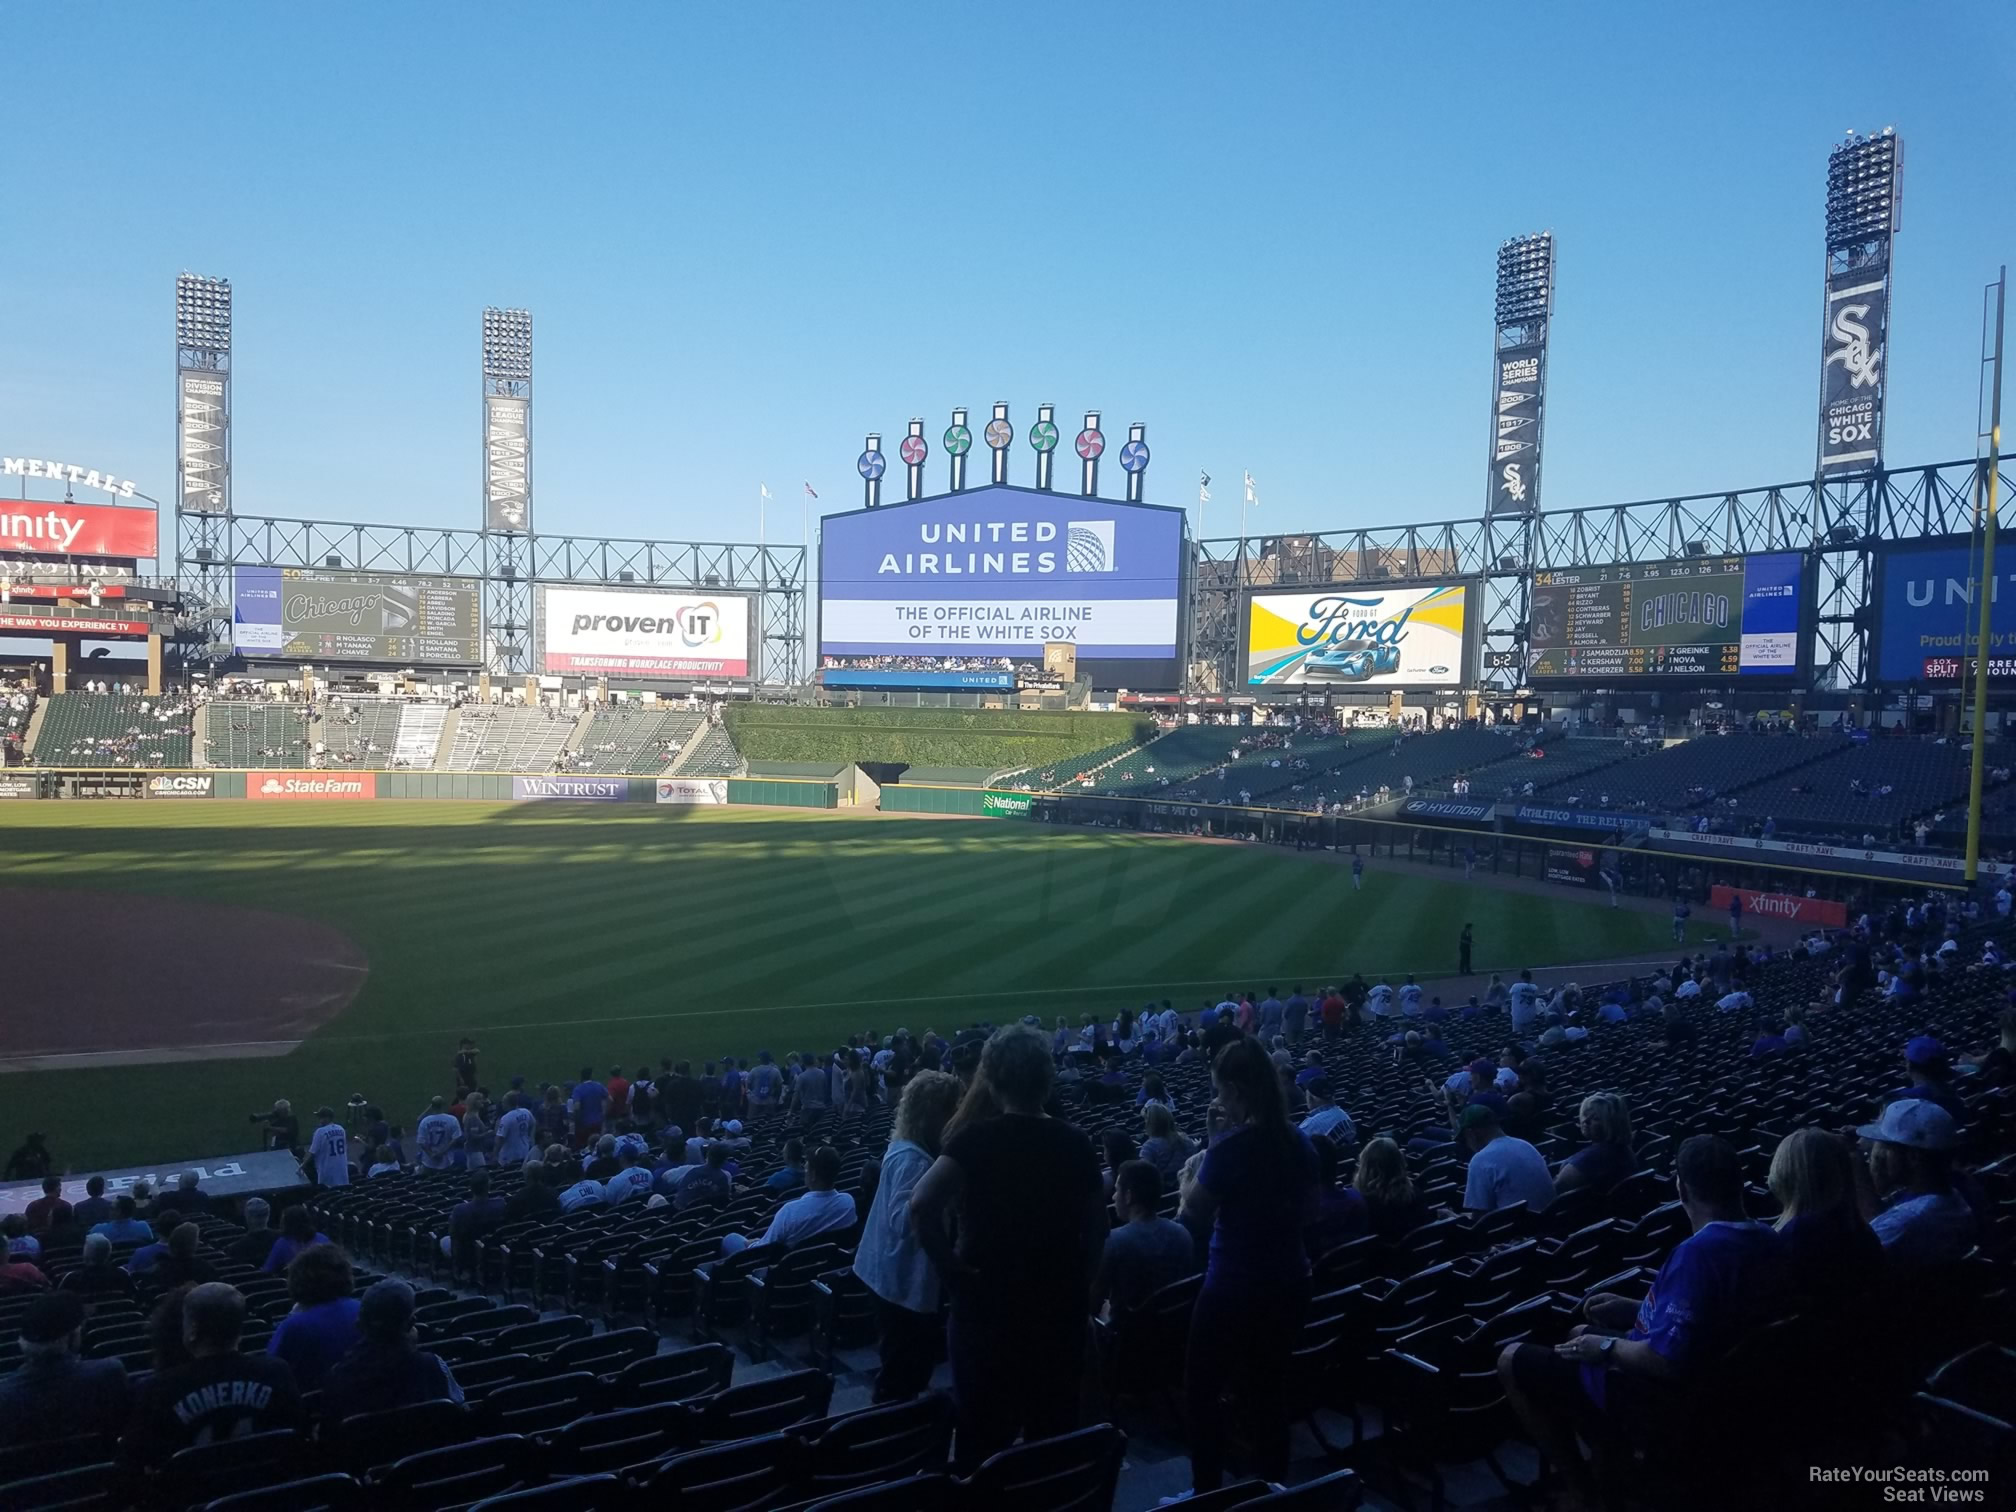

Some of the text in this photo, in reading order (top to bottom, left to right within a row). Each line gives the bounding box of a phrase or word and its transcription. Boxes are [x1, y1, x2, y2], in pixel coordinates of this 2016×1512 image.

[1502, 358, 1538, 371] WORLD
[1502, 366, 1538, 380] SERIES
[185, 382, 222, 391] DIVISION
[1502, 376, 1537, 386] CHAMPIONS
[1501, 394, 1524, 404] 2005
[1830, 398, 1849, 407] HOME
[1850, 396, 1859, 405] OF
[491, 406, 524, 414] AMERICAN
[1829, 402, 1873, 416] CHICAGO
[491, 412, 524, 420] LEAGUE
[1829, 411, 1873, 427] WHITE
[1501, 419, 1523, 428] 1917
[1829, 423, 1872, 445] SOX
[3, 457, 137, 498] MENTALS
[921, 522, 1057, 544] UNITED
[877, 552, 1058, 574] AIRLINES
[283, 568, 301, 580] 50
[1535, 573, 1552, 586] 34
[1552, 576, 1580, 585] LESTER
[1644, 570, 1659, 578] 3.95
[1670, 568, 1690, 576] 123.0
[12, 586, 35, 595] xfinity
[1906, 574, 2016, 607] UNI
[285, 593, 382, 626] Chicago
[896, 606, 1093, 621] THE OFFICIAL AIRLINE
[1575, 605, 1610, 613] CONTRERAS
[1641, 592, 1729, 632] CHICAGO
[1297, 597, 1414, 645] Ford
[1575, 612, 1611, 620] SCHWARBER
[16, 618, 129, 631] WAY YOU EXPERIENCE TV
[571, 614, 711, 636] proven IT
[908, 625, 1077, 640] OF THE WHITE SOX
[1920, 635, 1961, 646] Proud
[1586, 648, 1644, 657] SAMARDZIJA 8.59
[1721, 655, 1738, 663] 4.59
[570, 656, 724, 671] TRANSFORMING WORKPLACE PRODUCTIVITY
[1628, 665, 1643, 673] 5.58
[1721, 664, 1737, 672] 4.58
[1926, 664, 1958, 674] SPLIT
[962, 676, 997, 684] UNITED
[1024, 681, 1061, 690] The PrivateBank
[173, 777, 212, 790] CSN
[522, 778, 619, 796] WINTRUST
[993, 797, 1030, 810] National
[1427, 803, 1485, 817] HYUNDAI
[1519, 806, 1597, 825] ATHLETICO THE
[1691, 834, 1712, 843] CRAFT
[1786, 843, 1809, 853] CRAFT
[1902, 855, 1929, 865] CRAFT
[1749, 894, 1802, 918] xfinity
[173, 1380, 273, 1425] KONERKO
